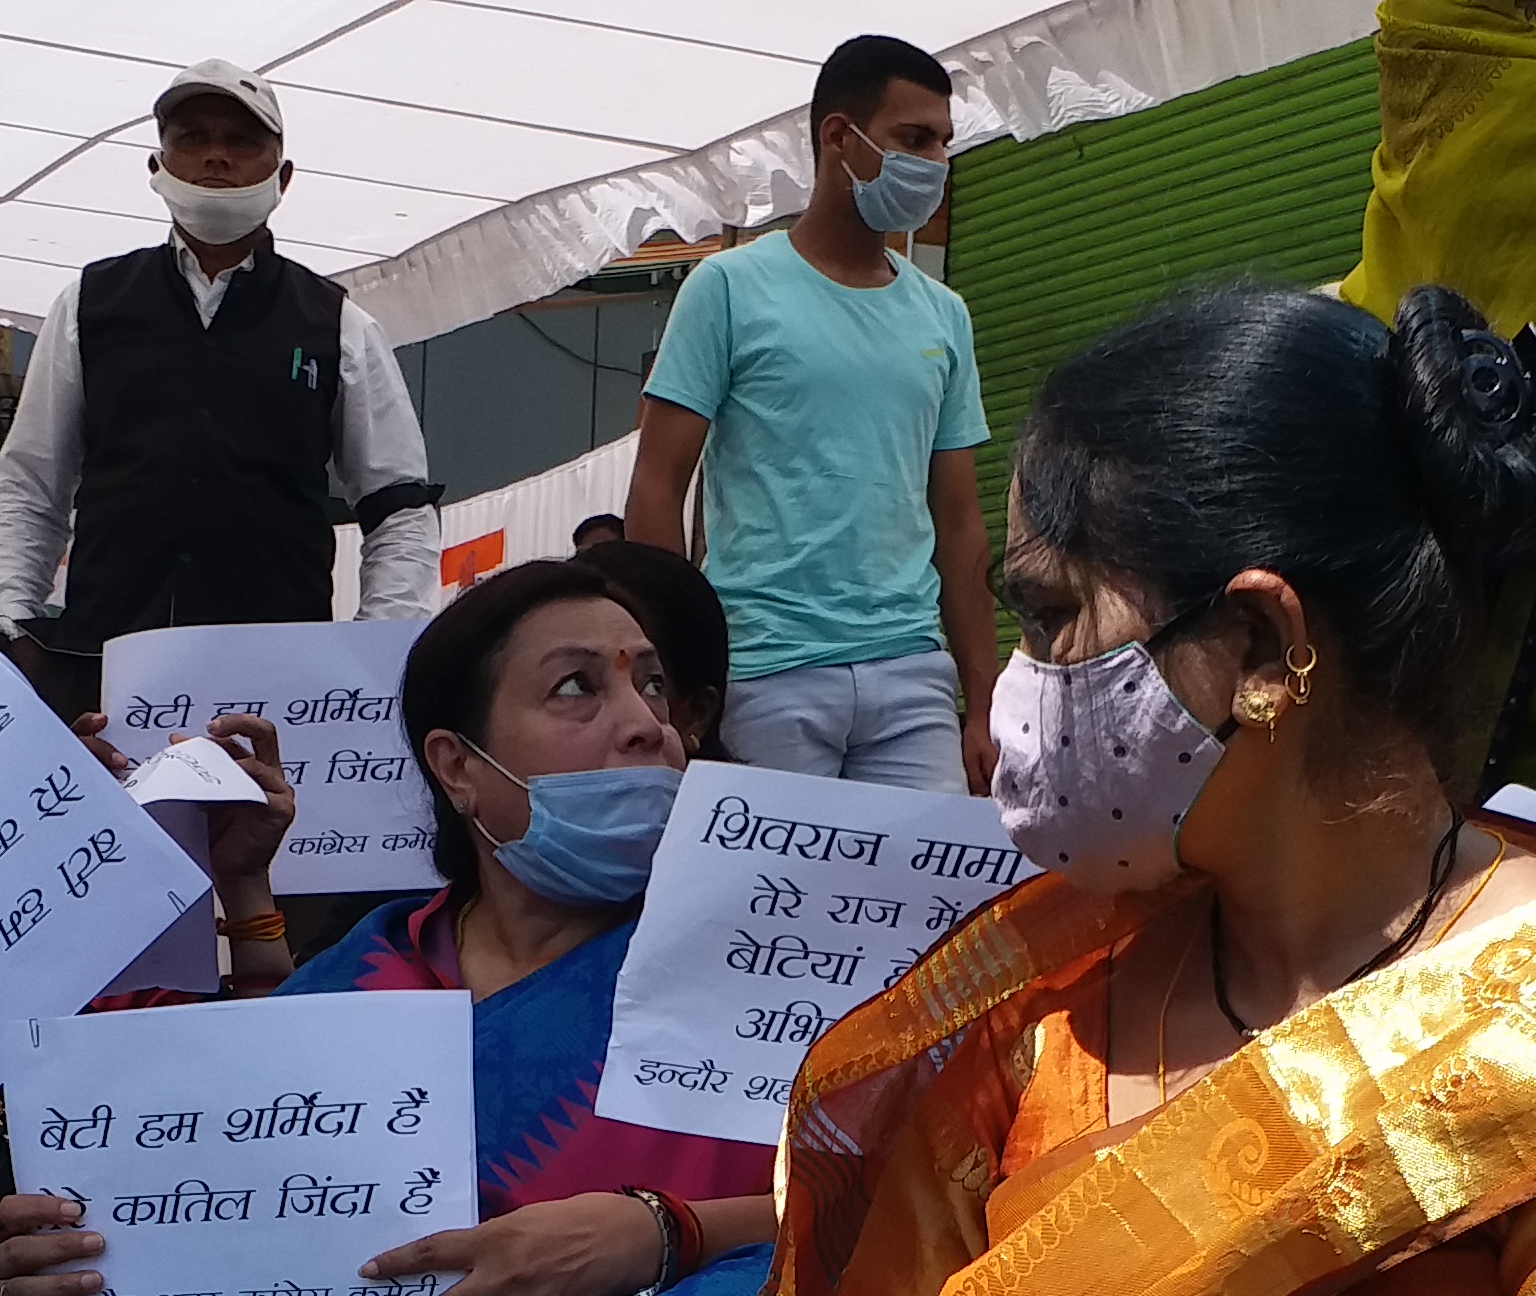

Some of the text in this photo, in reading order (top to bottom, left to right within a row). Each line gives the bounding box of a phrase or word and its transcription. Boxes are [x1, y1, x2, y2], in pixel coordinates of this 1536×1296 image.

[126, 694, 195, 729] बेटी
[283, 687, 399, 726] शर्मिंदा
[28, 764, 86, 821] तेरे
[325, 748, 410, 785] जिंदा
[56, 827, 127, 899] बेटी
[289, 829, 370, 856] कांग्रेस
[700, 796, 1024, 886] शिवराज मामा
[750, 873, 964, 930] तेरे राज में
[727, 929, 865, 986] बेटियां
[735, 1000, 837, 1047] अभि
[634, 1059, 793, 1106] इन्दौर शह
[40, 1104, 116, 1151] बेटी
[136, 1112, 204, 1148] हम
[222, 1091, 367, 1142] शर्मिंदा
[113, 1180, 256, 1226] कातिल
[275, 1174, 381, 1218] जिंदा
